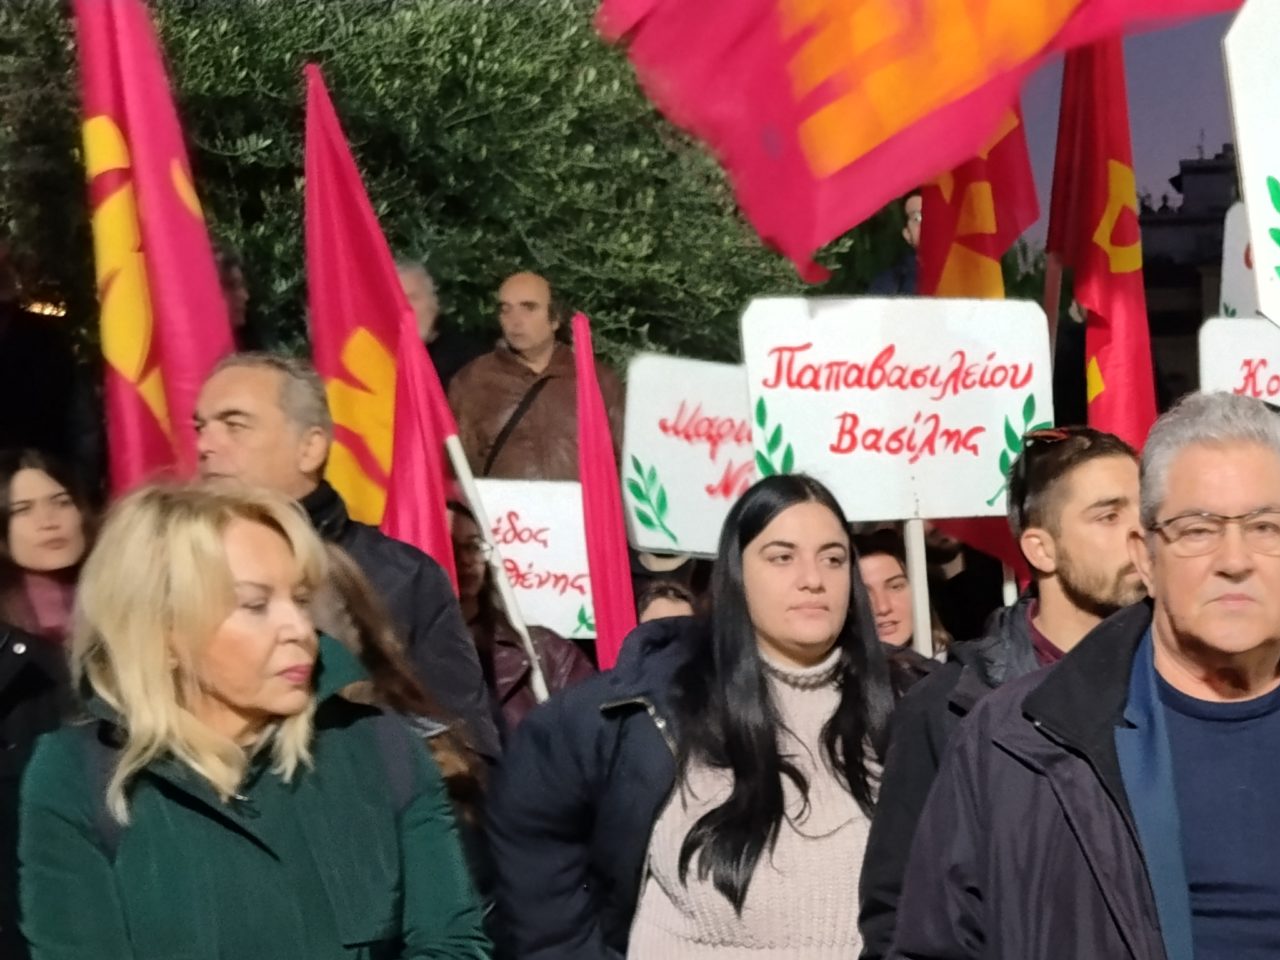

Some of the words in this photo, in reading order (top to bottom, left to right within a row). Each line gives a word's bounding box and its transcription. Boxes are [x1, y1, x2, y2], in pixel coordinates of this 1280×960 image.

[762, 343, 1033, 401] Παπαβασιλείου
[829, 411, 986, 463] Βασίλης
[491, 511, 550, 548] έδος
[502, 558, 588, 597] θένης
